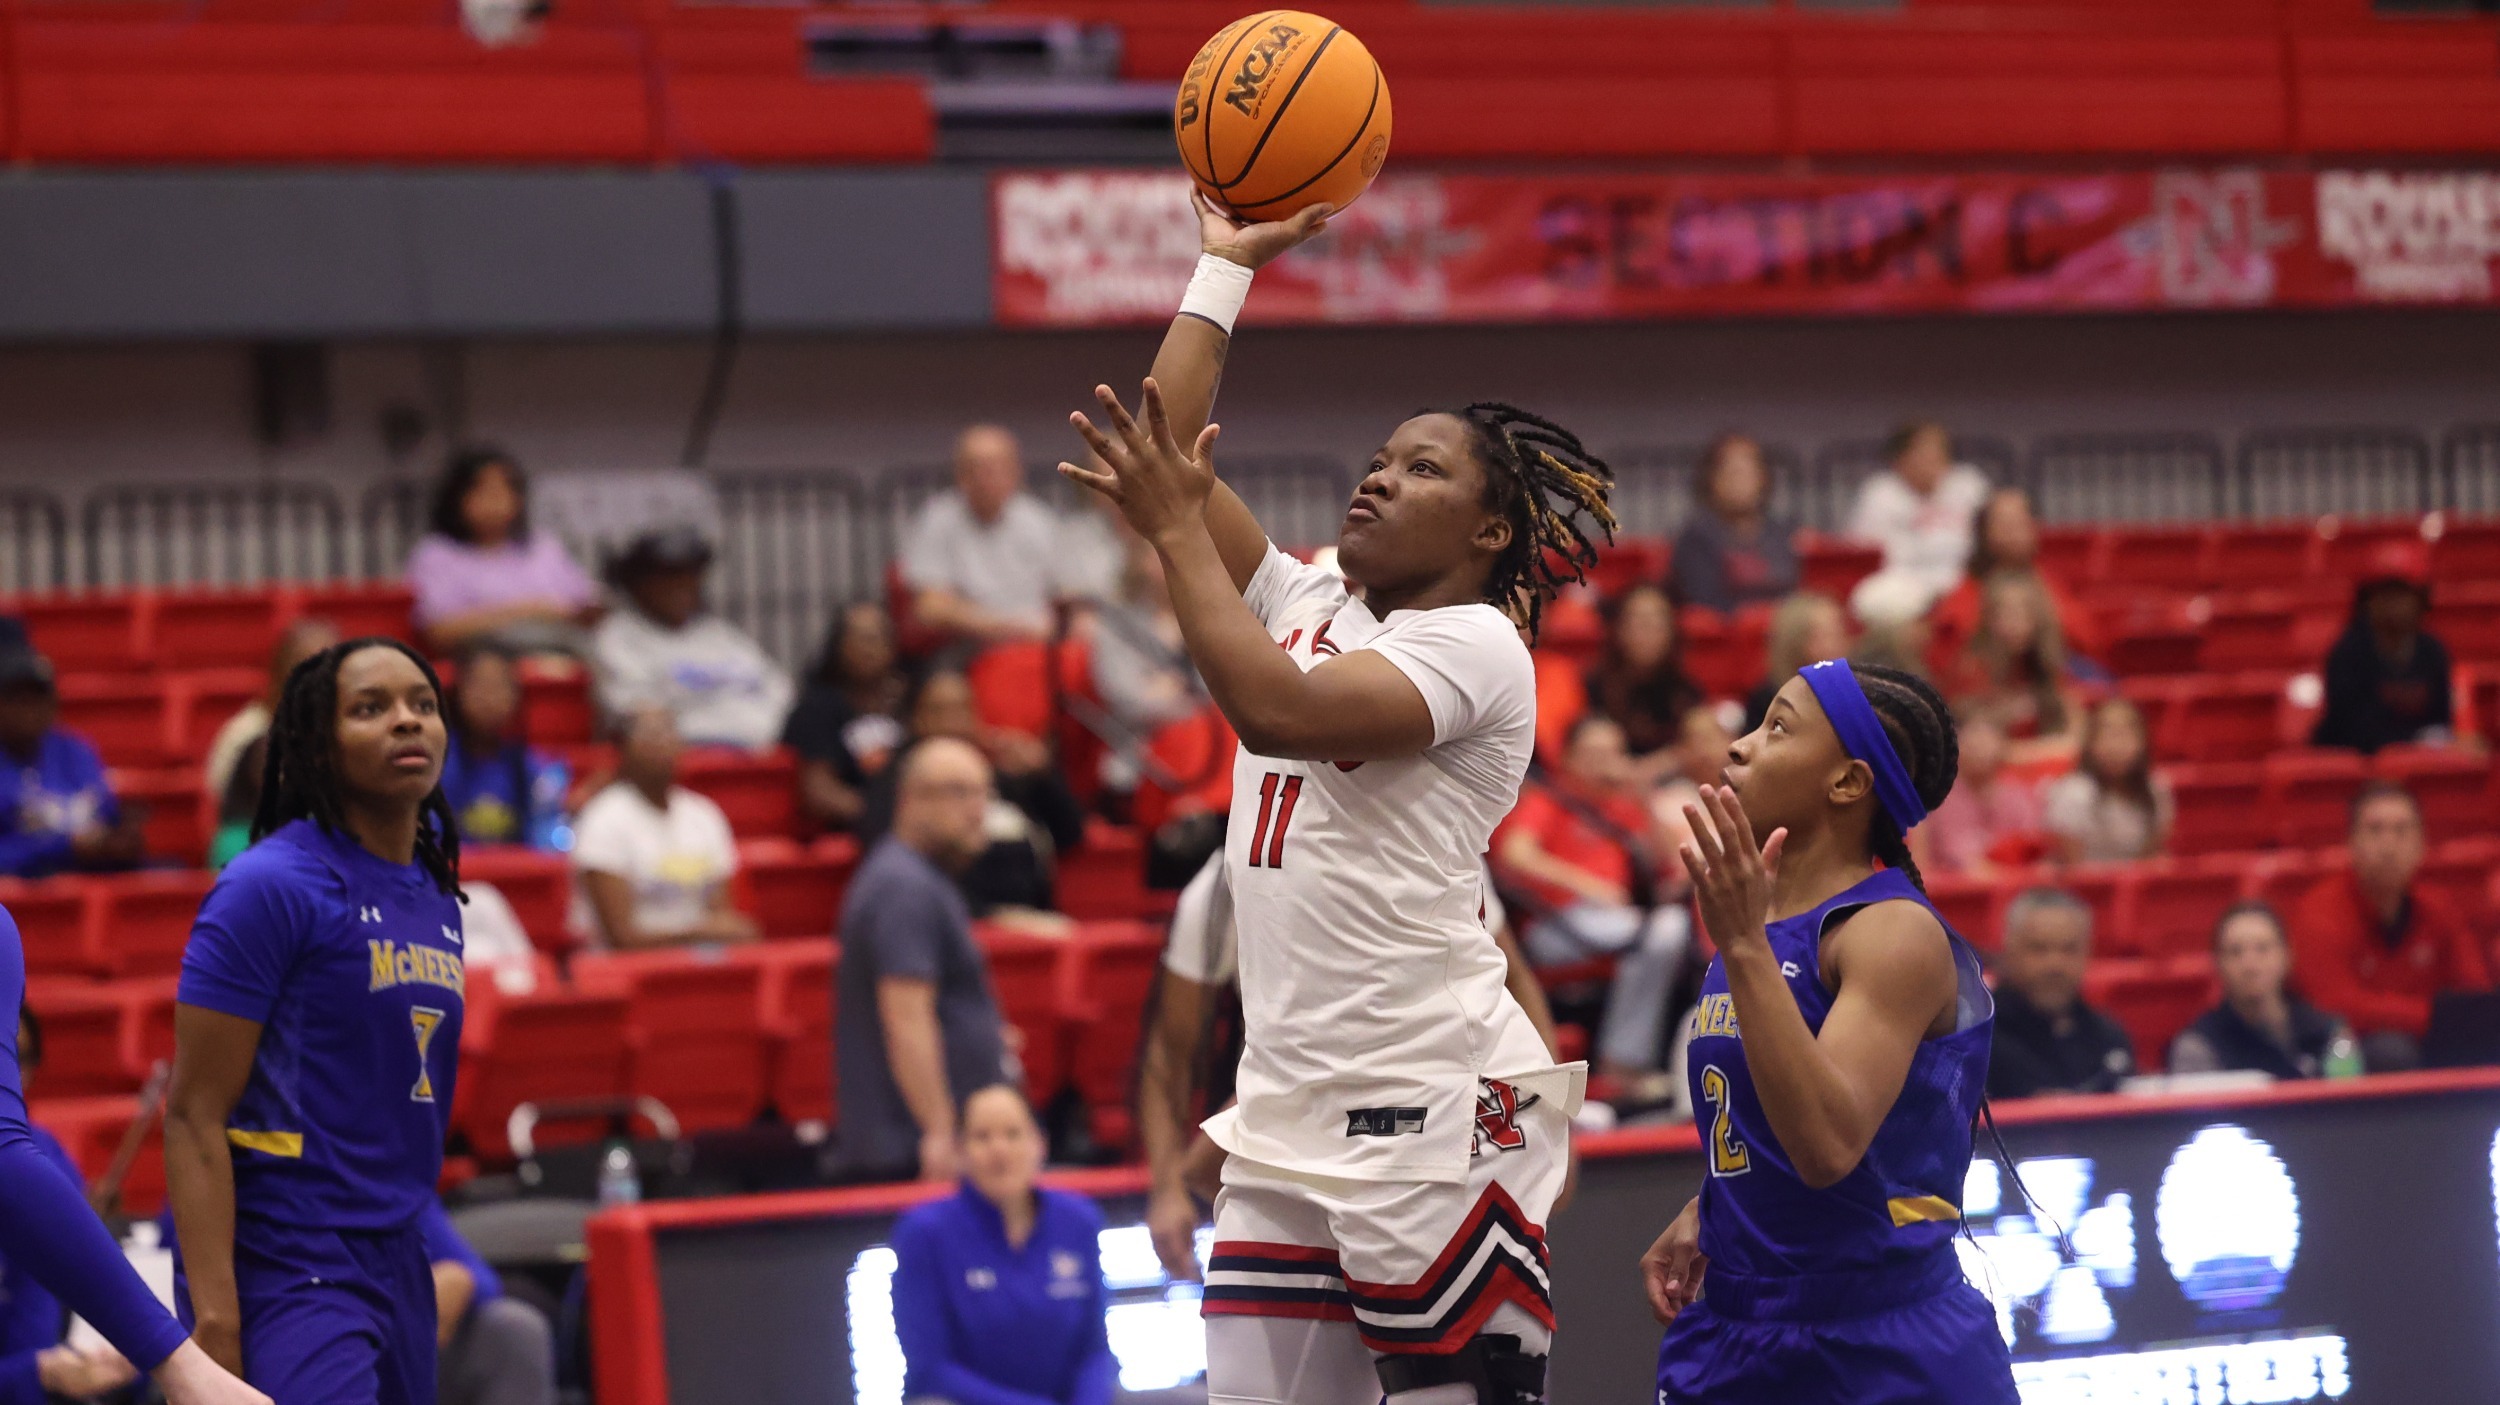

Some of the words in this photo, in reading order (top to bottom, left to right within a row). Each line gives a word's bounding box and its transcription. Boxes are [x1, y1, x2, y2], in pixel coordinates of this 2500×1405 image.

[1224, 25, 1302, 117] NCAA
[1536, 192, 1964, 287] SECTION
[1249, 772, 1304, 869] 11
[410, 1005, 446, 1103] 7
[1701, 1064, 1752, 1178] 2
